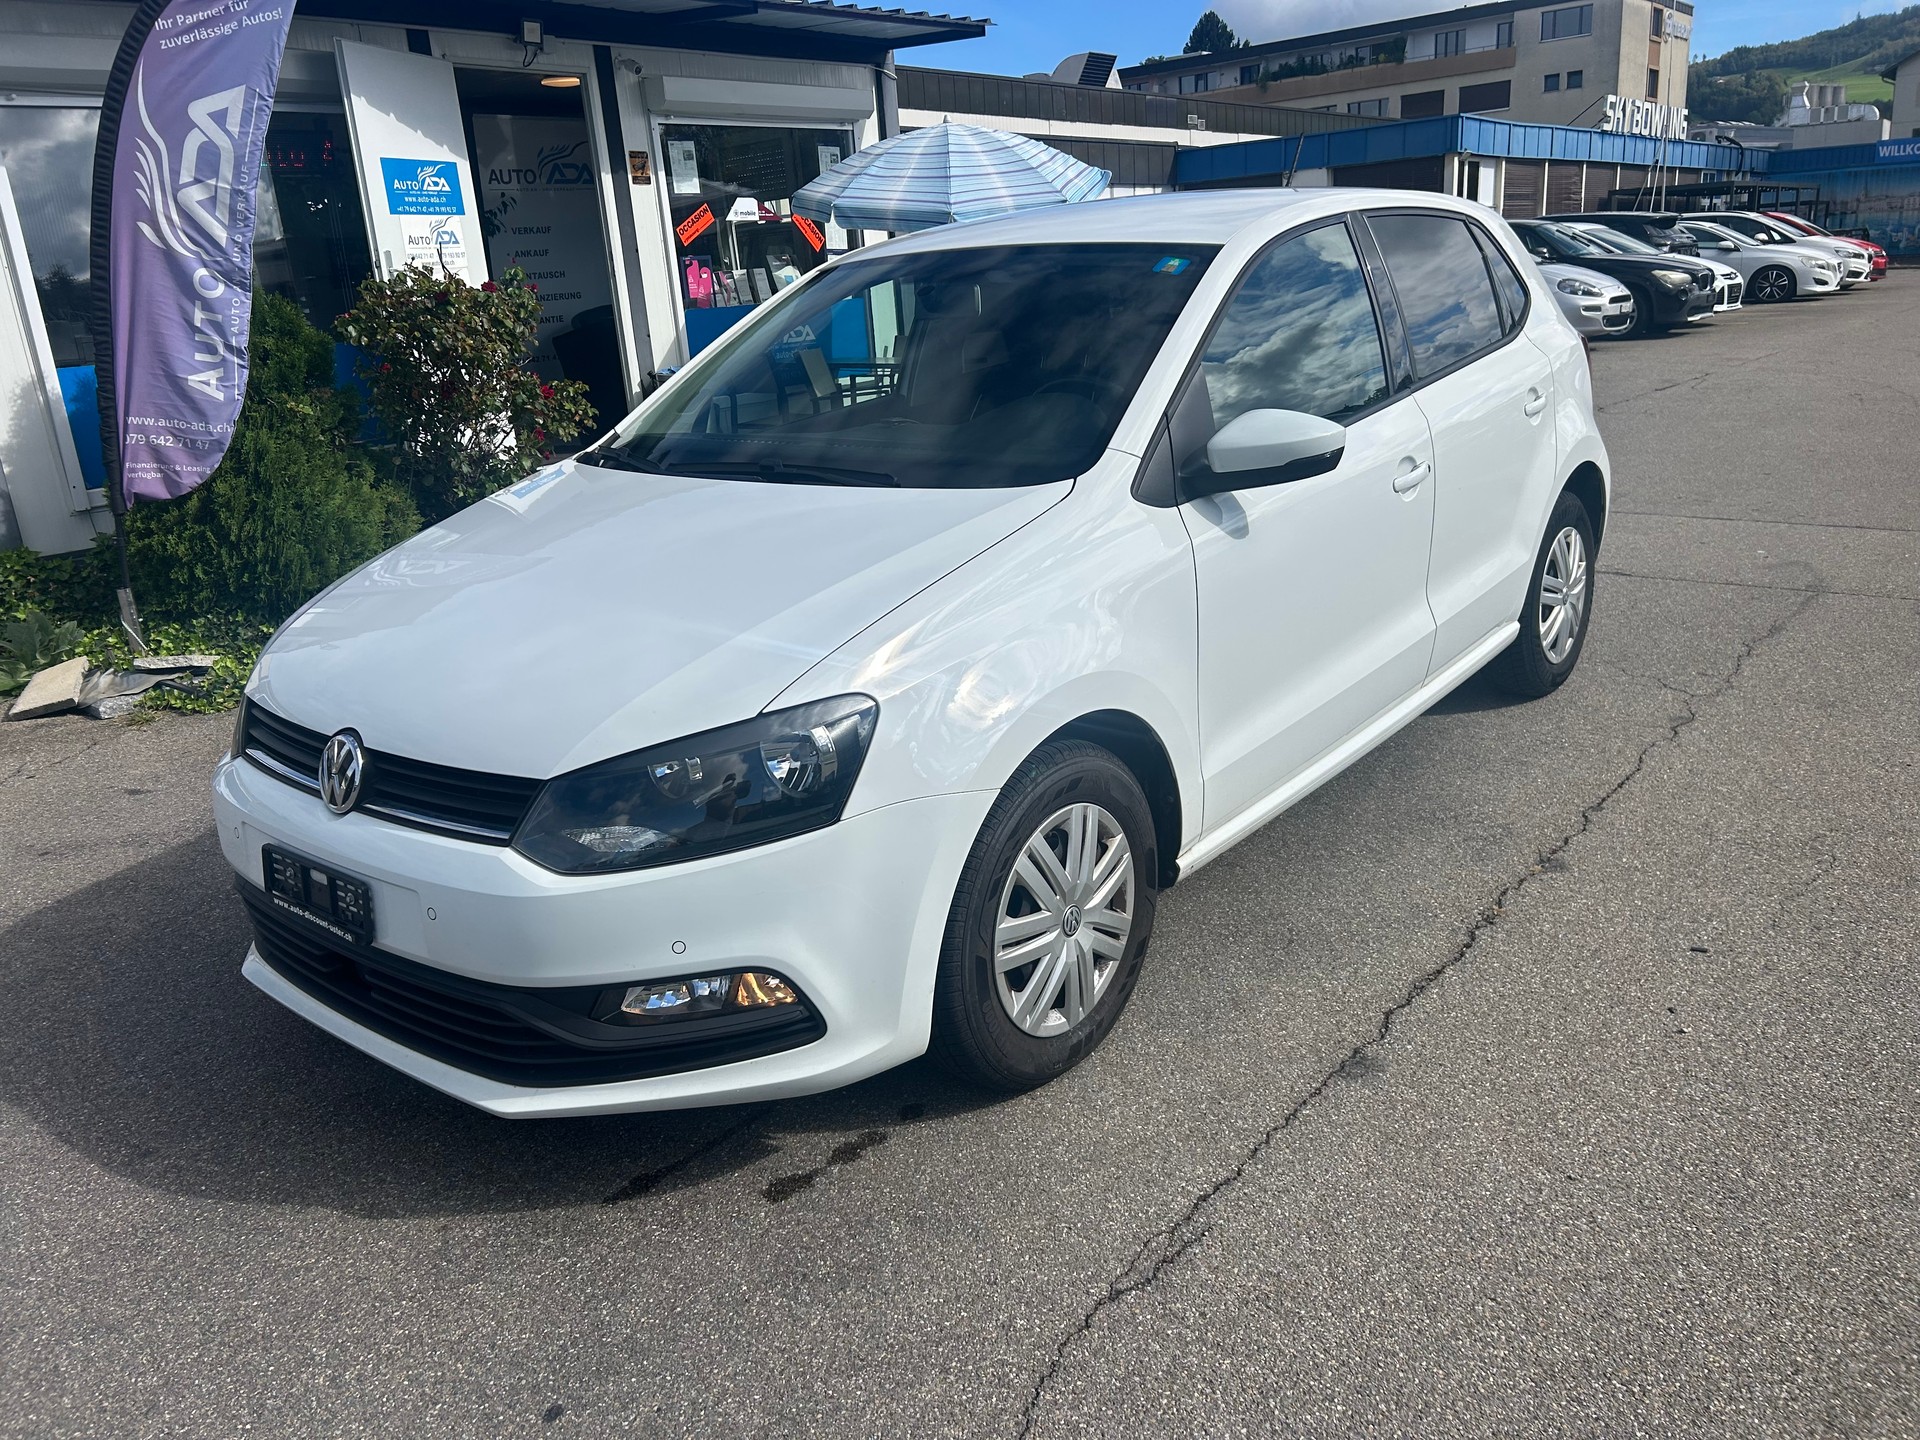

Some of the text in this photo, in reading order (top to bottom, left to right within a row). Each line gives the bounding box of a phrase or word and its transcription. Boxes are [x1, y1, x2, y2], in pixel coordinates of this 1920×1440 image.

[154, 0, 251, 31] Ihr Partner für
[159, 7, 284, 50] zuverlässige Autos!
[487, 162, 595, 185] AUTO ADA
[393, 176, 451, 191] AUTO ADA
[739, 208, 757, 217] mobile
[678, 205, 709, 236] OCCASION
[511, 225, 552, 235] VERKAUF
[801, 216, 823, 244] CASION
[408, 234, 431, 246] AUTO
[230, 297, 241, 334] AUTO
[236, 165, 250, 230] VERKAUF
[514, 248, 550, 258] ANKAUF
[524, 270, 566, 280] NTAUSCH
[533, 291, 582, 302] ANZIERUNG
[535, 315, 565, 325] ANTIE
[188, 267, 225, 402] AUTO
[149, 434, 174, 447] 642
[176, 436, 191, 448] 71
[195, 438, 210, 450] 47
[126, 462, 174, 472] Finanzierung
[183, 465, 211, 474] Leasing
[127, 471, 165, 480] verfügbar
